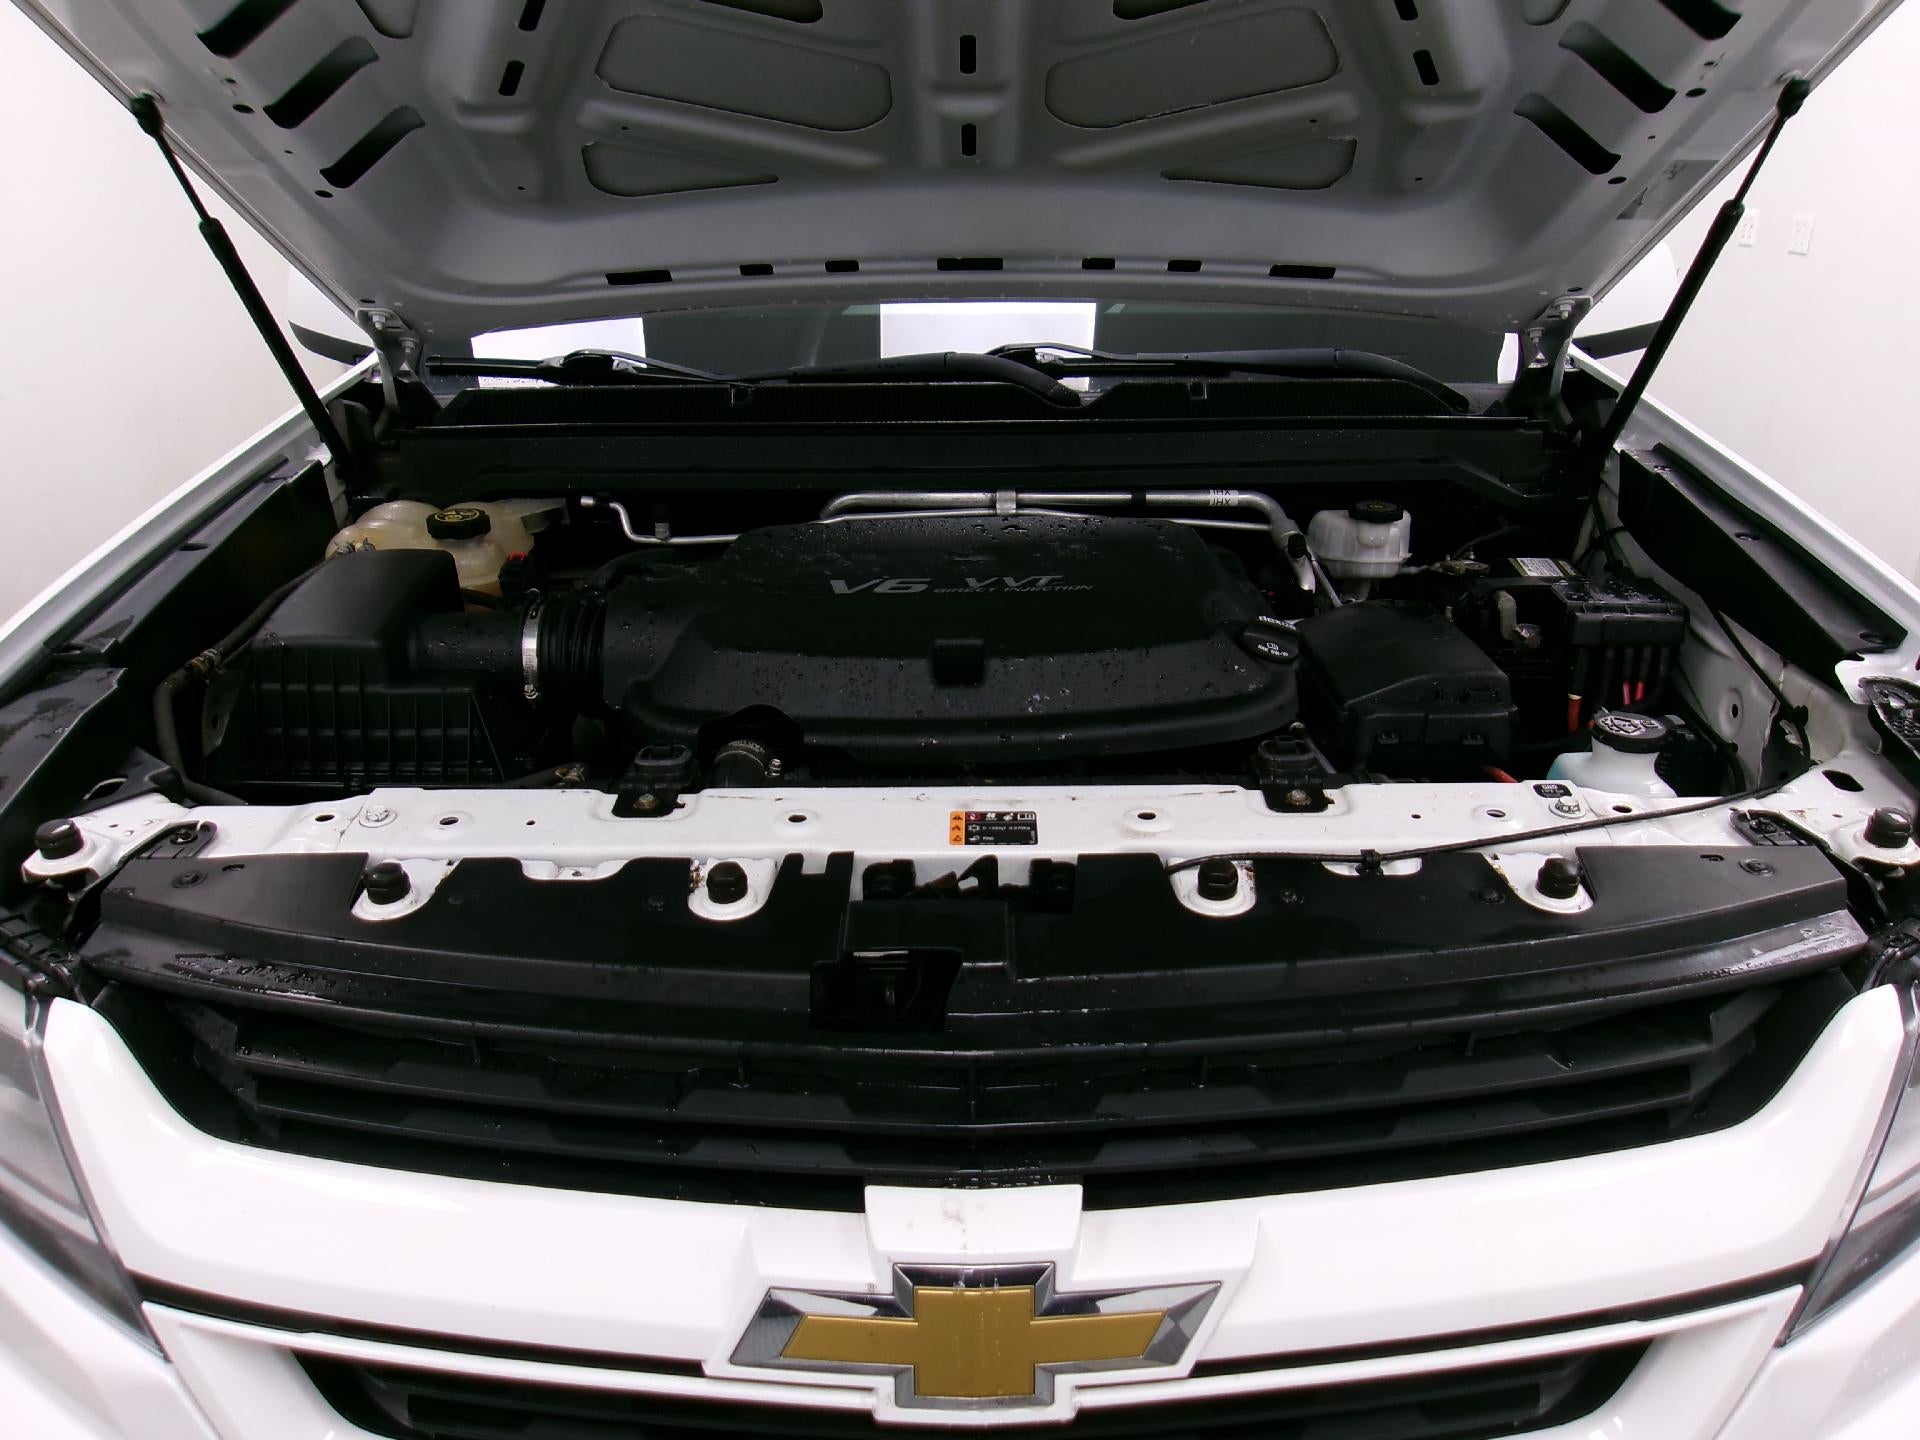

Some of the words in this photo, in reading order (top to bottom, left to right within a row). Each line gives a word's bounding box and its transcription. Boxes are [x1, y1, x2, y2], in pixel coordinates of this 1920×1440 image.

[829, 577, 931, 594] V6
[964, 575, 1065, 588] VVT
[1003, 584, 1095, 593] INJECTION
